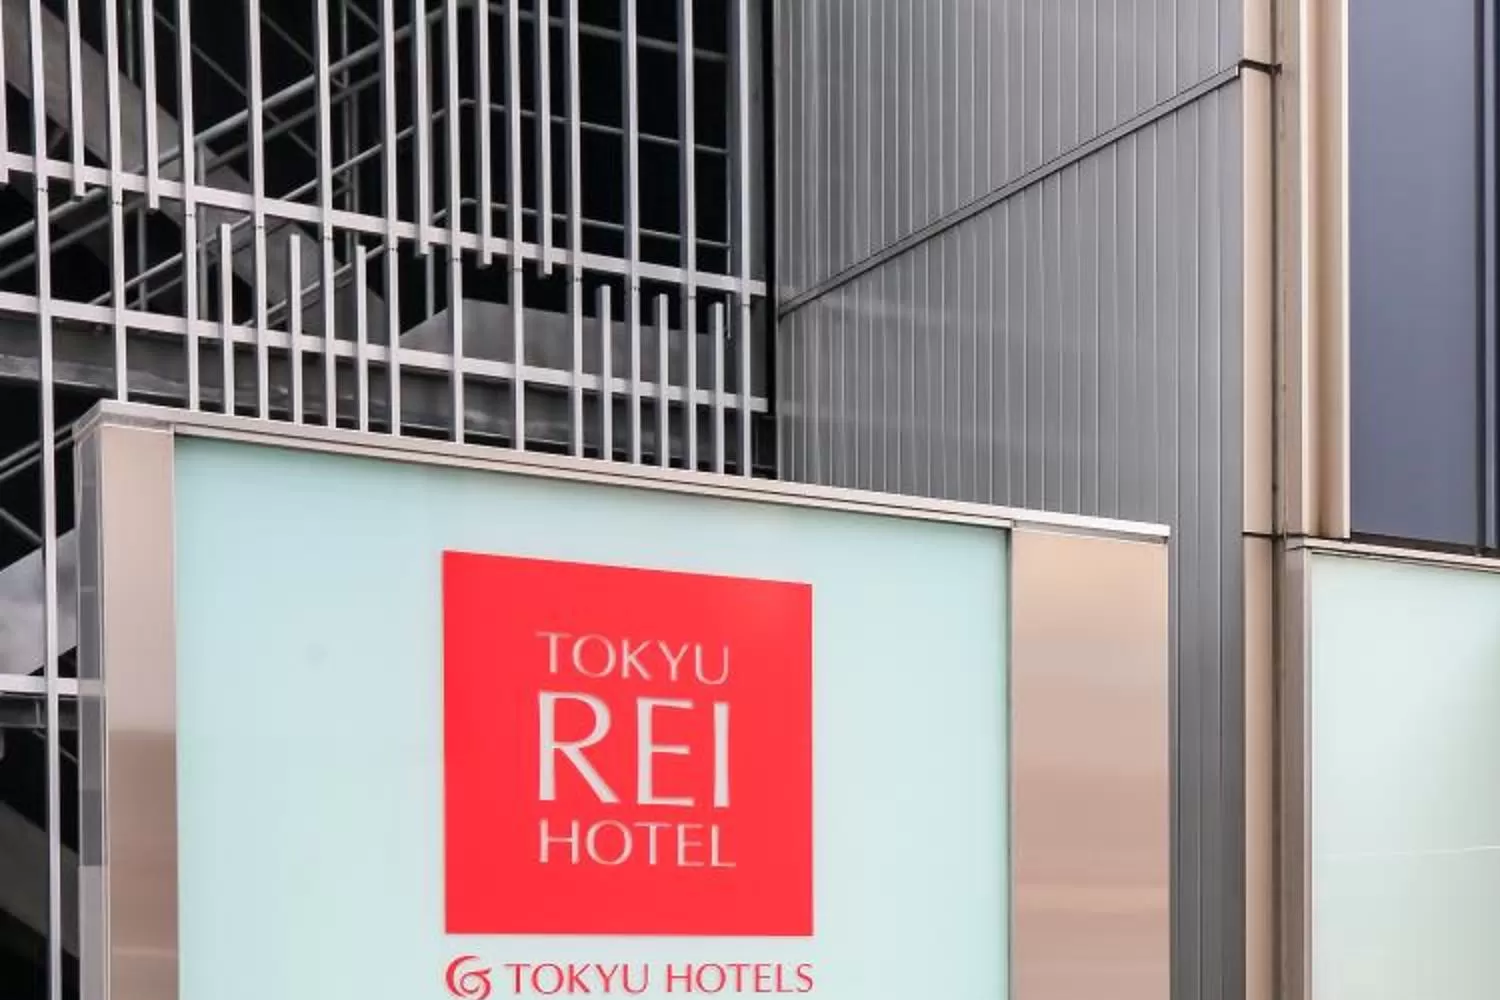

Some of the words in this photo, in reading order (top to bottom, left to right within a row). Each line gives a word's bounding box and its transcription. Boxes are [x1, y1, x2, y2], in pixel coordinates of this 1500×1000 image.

[536, 631, 730, 685] TOKYU
[538, 690, 730, 808] REI
[538, 819, 736, 868] HOTEL
[505, 962, 648, 993] TOKYU
[665, 962, 814, 993] HOTELS
